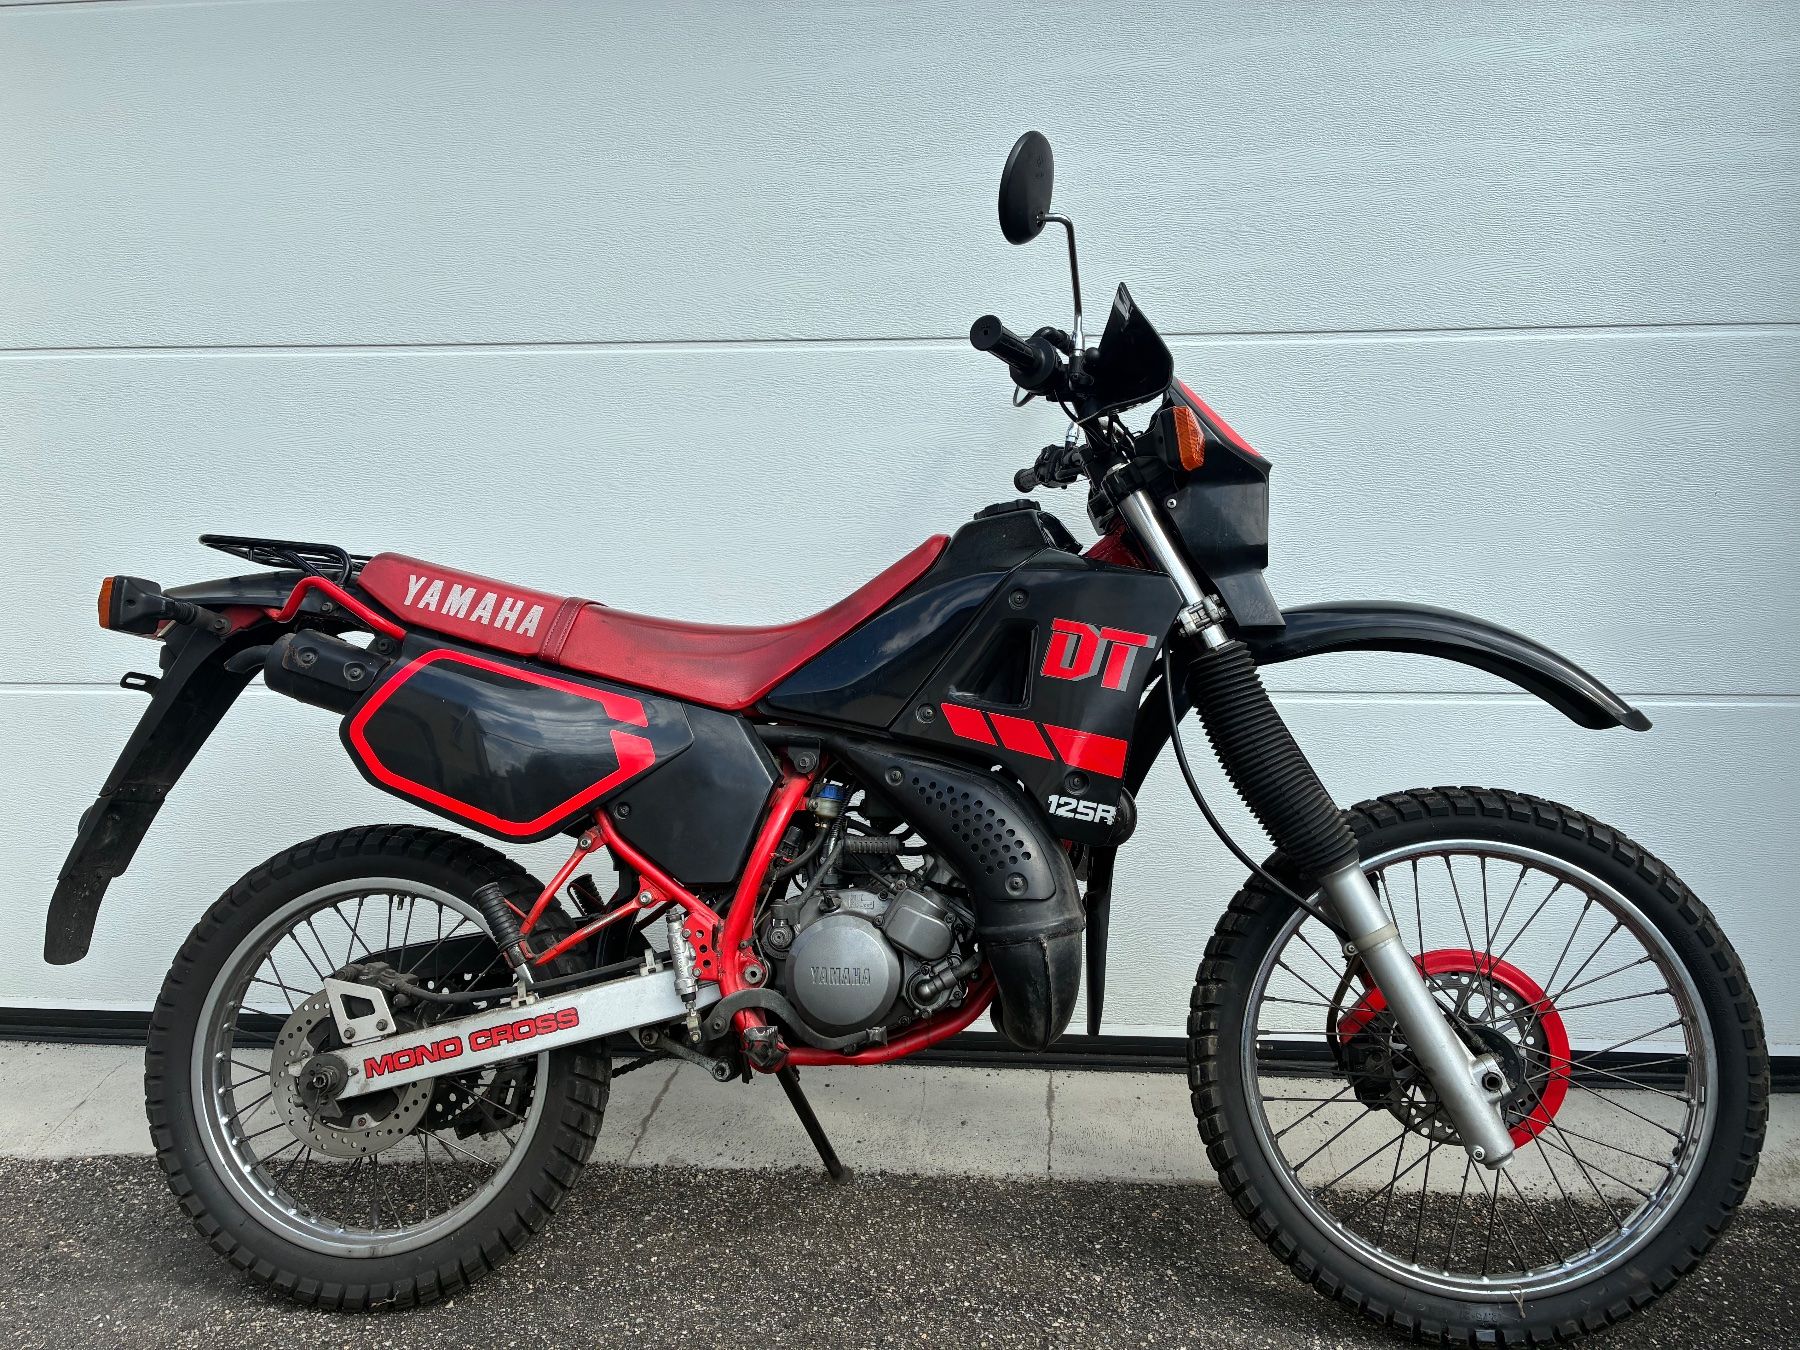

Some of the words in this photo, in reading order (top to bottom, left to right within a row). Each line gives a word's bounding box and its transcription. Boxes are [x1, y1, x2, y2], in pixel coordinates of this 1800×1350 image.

[403, 574, 545, 638] YAMAHA
[1040, 617, 1157, 692] DT
[1047, 794, 1118, 826] 125R
[810, 966, 871, 985] YAMAHA
[363, 1036, 464, 1079] MONO
[468, 1006, 580, 1052] CROSS
